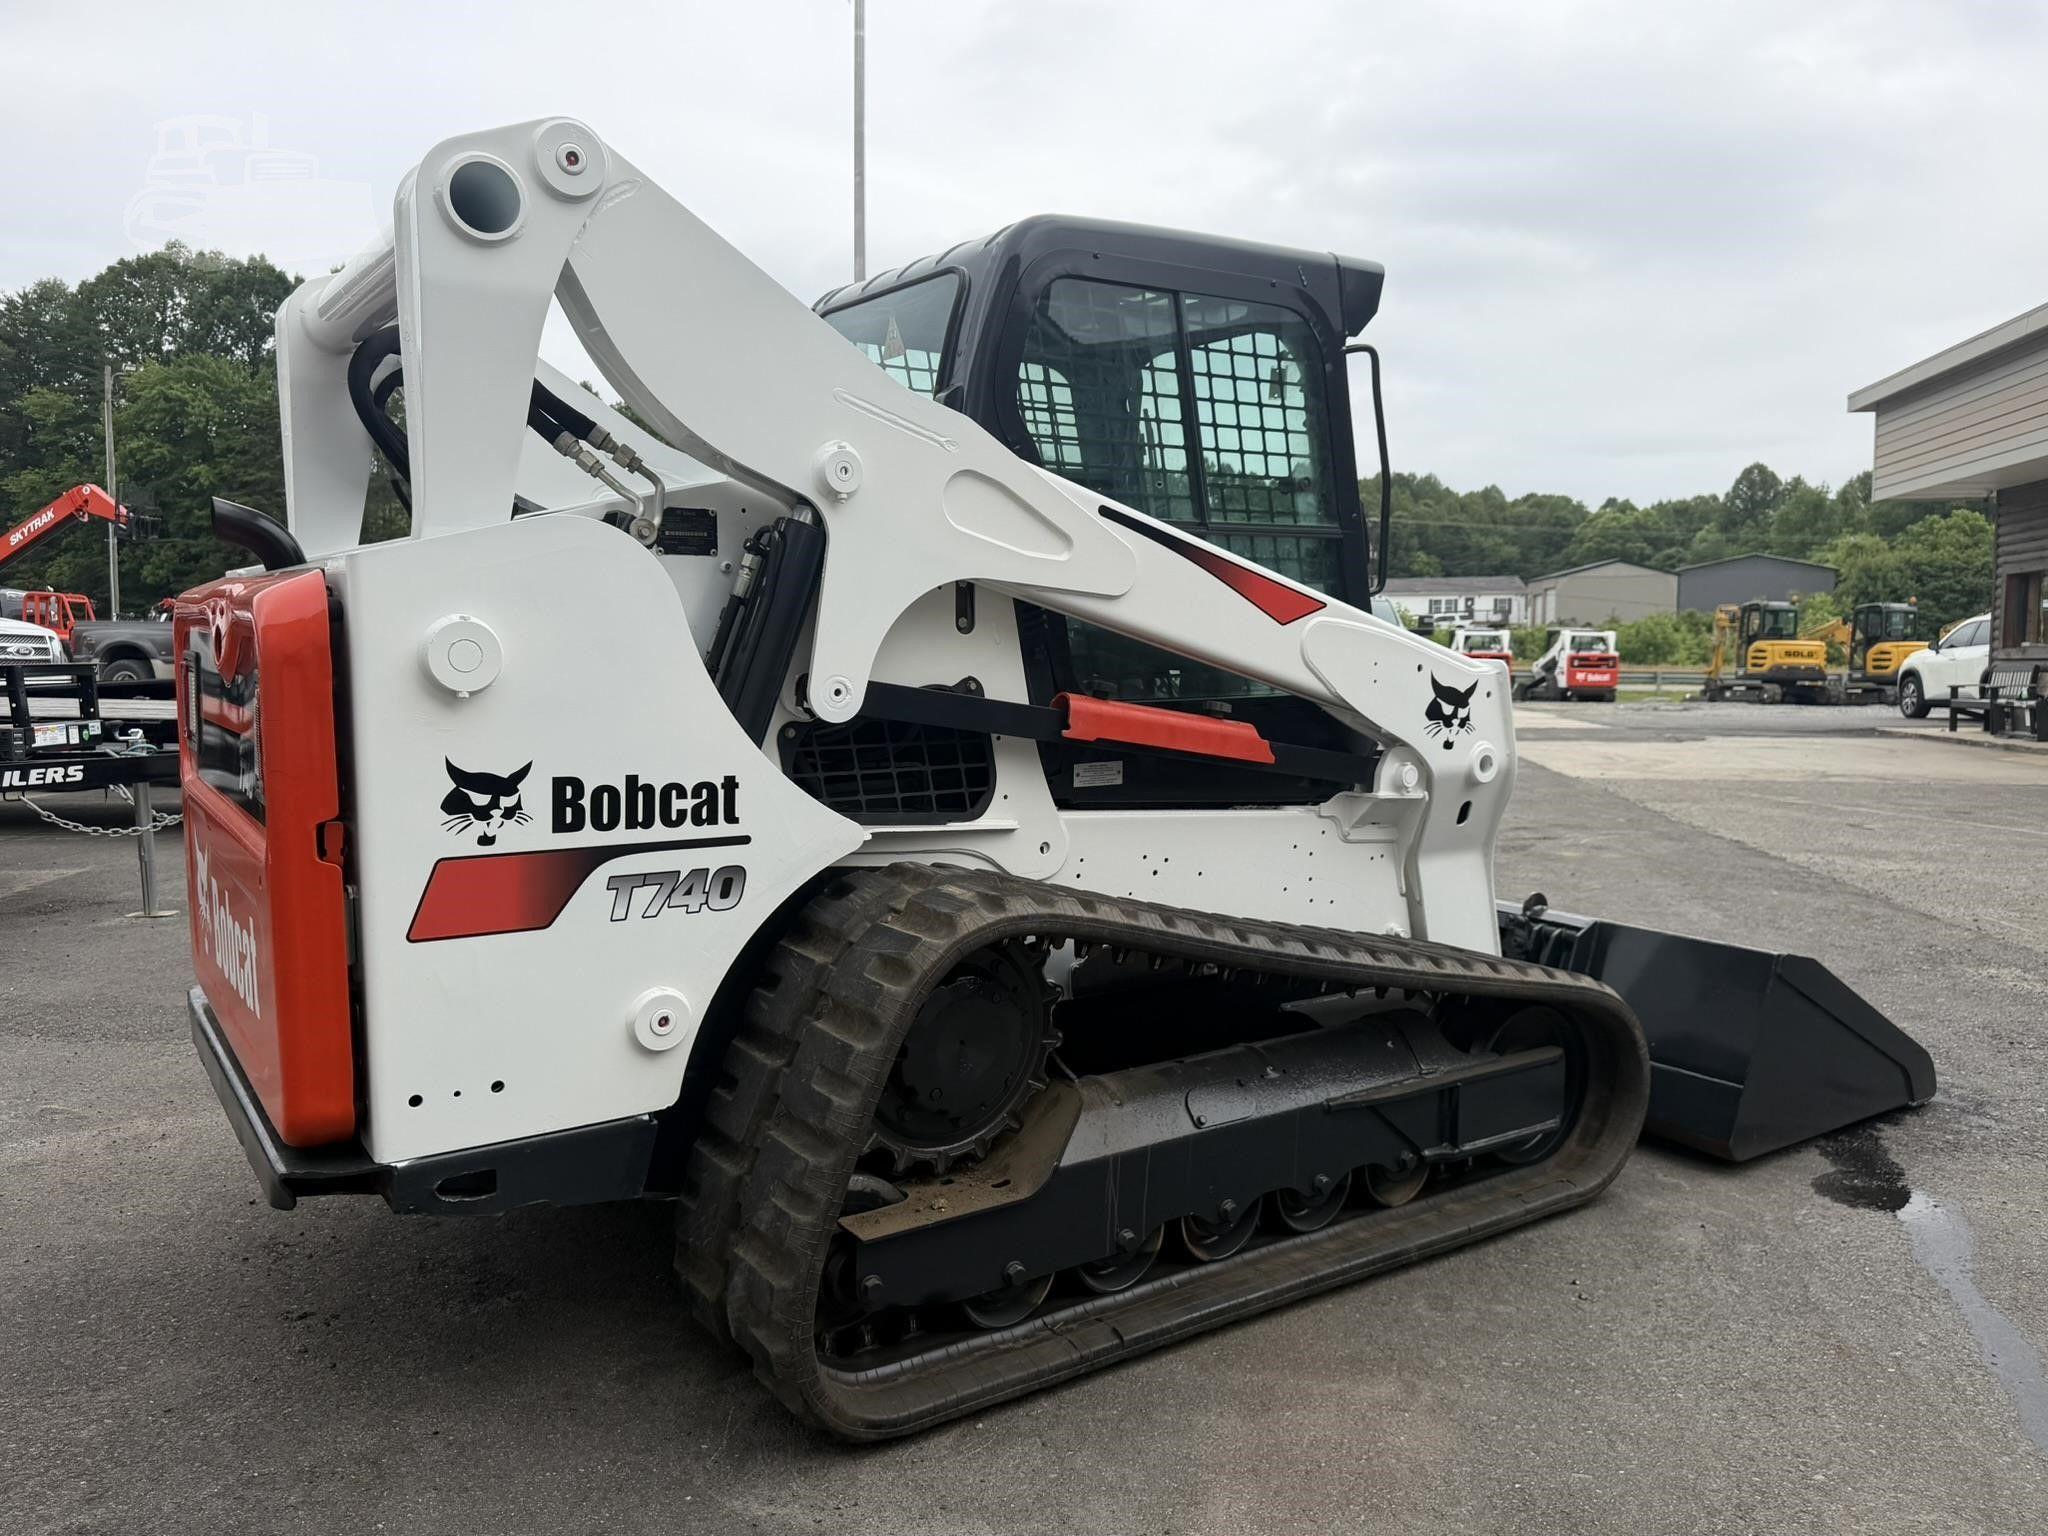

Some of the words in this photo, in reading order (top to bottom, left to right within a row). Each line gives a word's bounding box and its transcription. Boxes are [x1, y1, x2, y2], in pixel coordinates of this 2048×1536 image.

[9, 507, 55, 546] SKYTRAK
[551, 774, 739, 834] Bobcat
[606, 864, 747, 922] T740
[211, 876, 261, 1020] Bobcat
